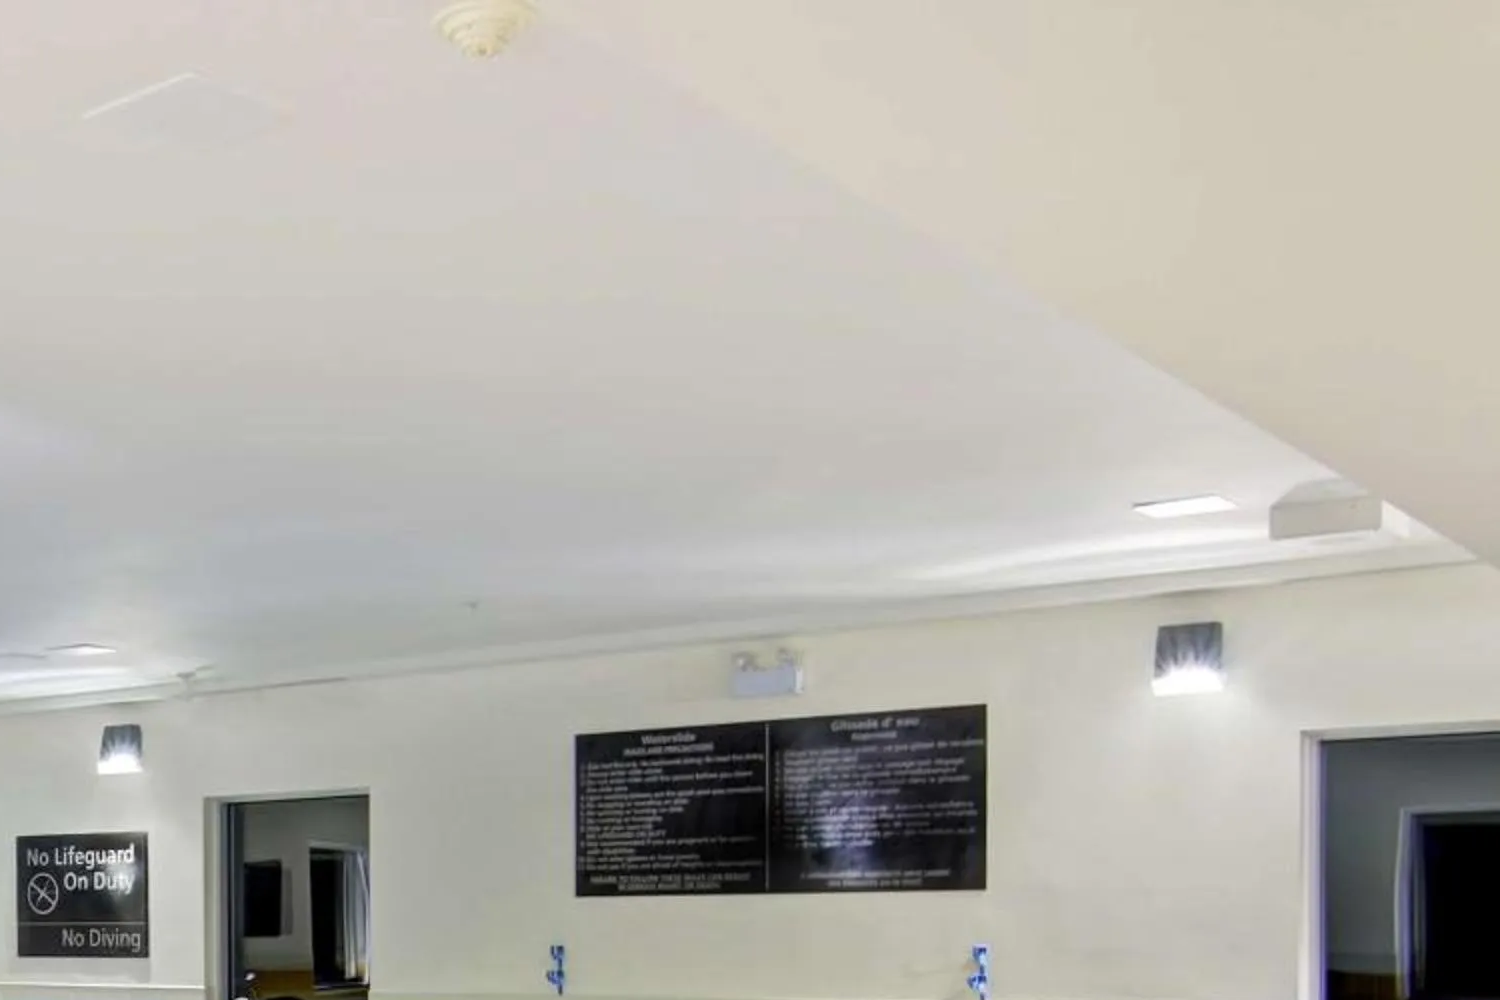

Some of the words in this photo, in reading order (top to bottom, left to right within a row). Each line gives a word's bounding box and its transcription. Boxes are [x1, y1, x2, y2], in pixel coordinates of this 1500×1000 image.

[26, 847, 49, 866] No
[54, 842, 135, 869] Lifeguard
[63, 871, 89, 890] On
[93, 871, 134, 894] Duty
[61, 928, 85, 947] No
[89, 928, 141, 952] Diving
